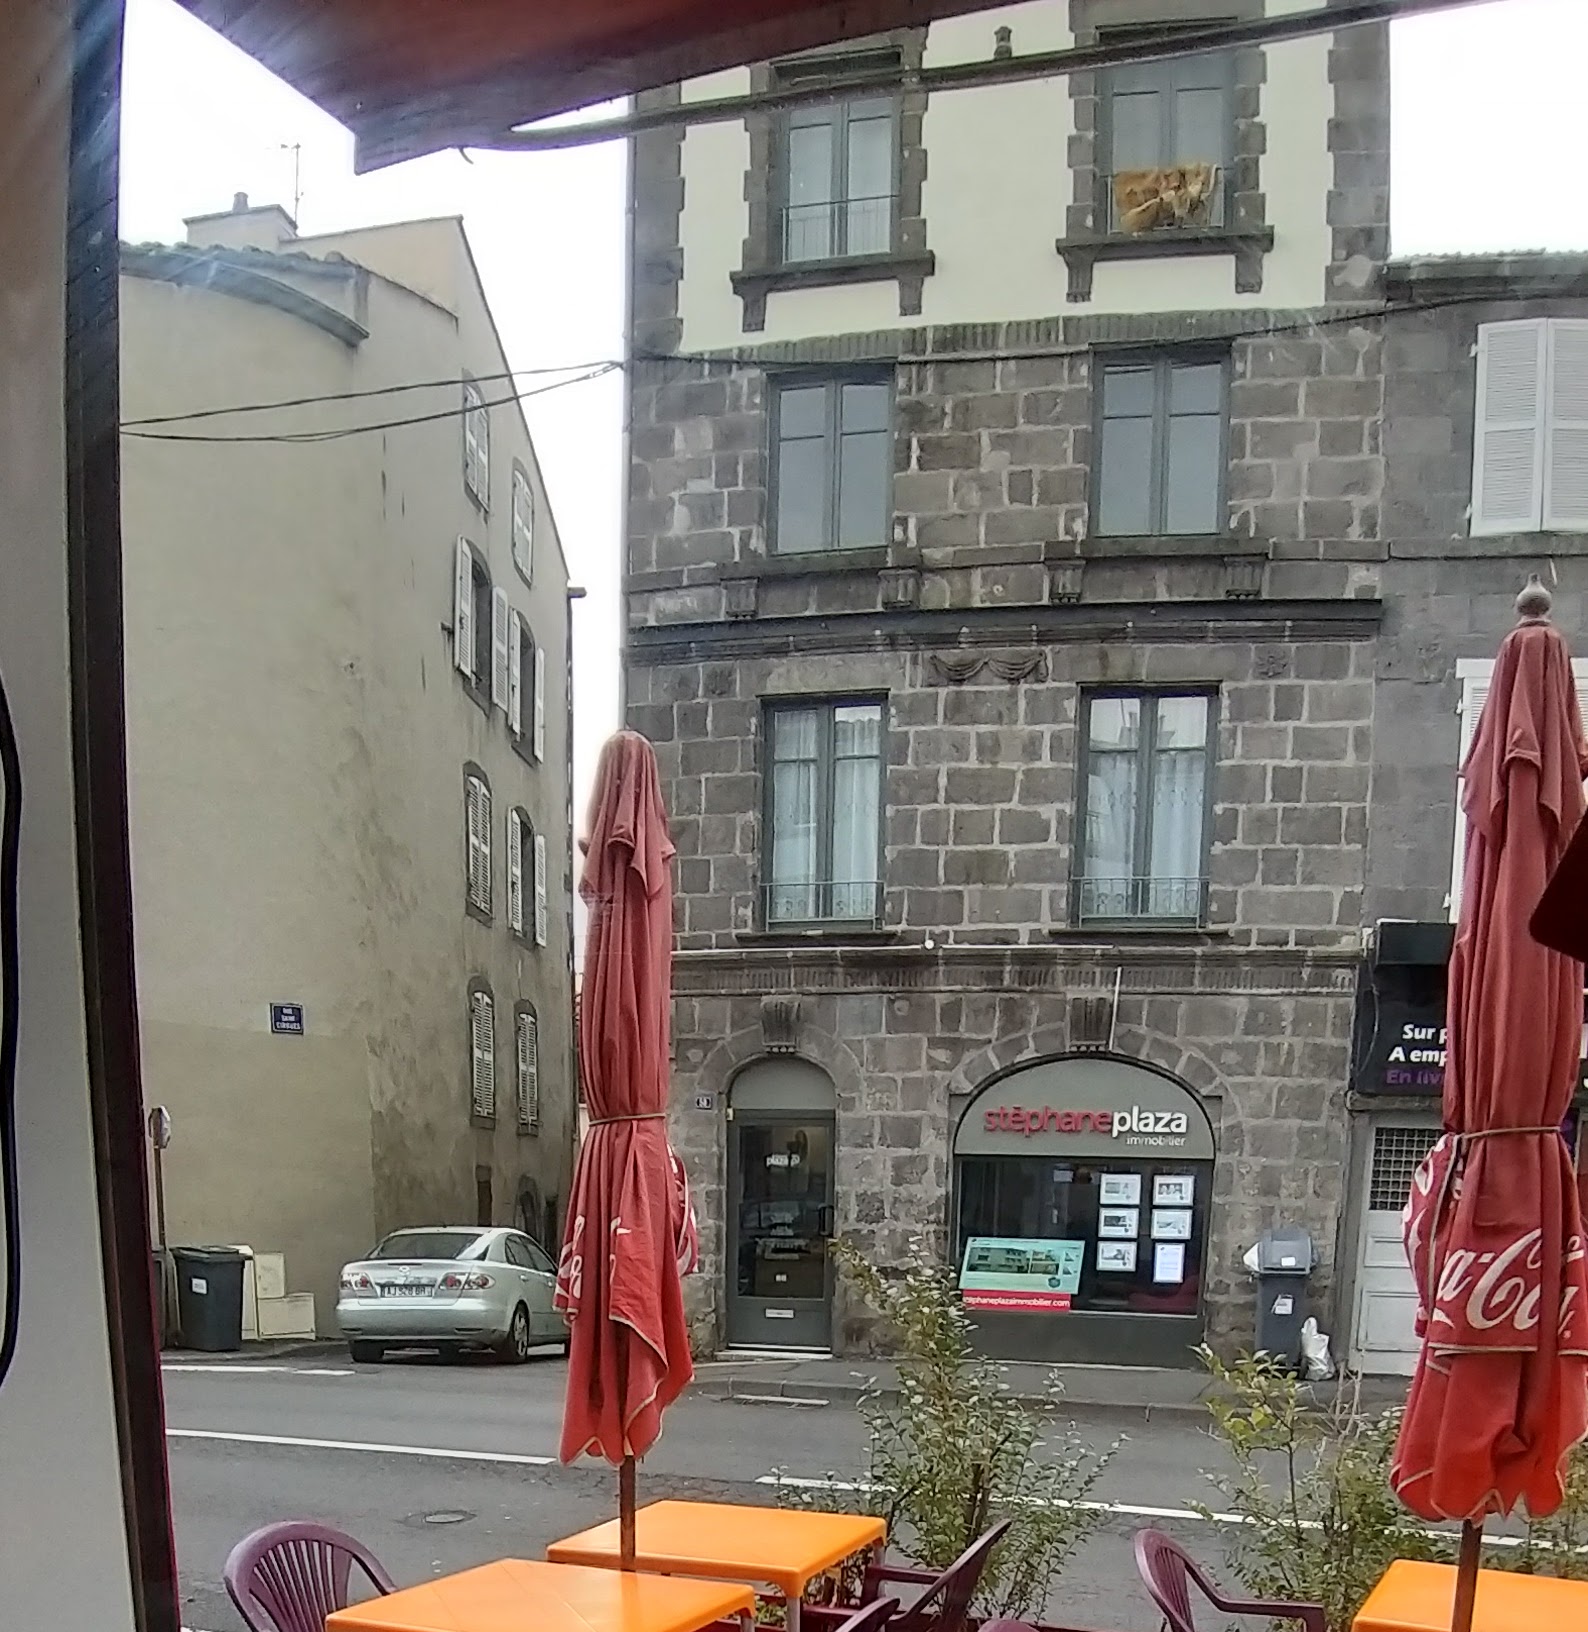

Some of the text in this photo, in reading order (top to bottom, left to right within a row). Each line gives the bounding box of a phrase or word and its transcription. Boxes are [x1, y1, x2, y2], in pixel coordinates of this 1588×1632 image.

[1402, 1023, 1436, 1040] Sur
[1388, 1046, 1447, 1067] A emp
[1386, 1069, 1445, 1084] En liv
[1126, 1135, 1186, 1147] immobilier
